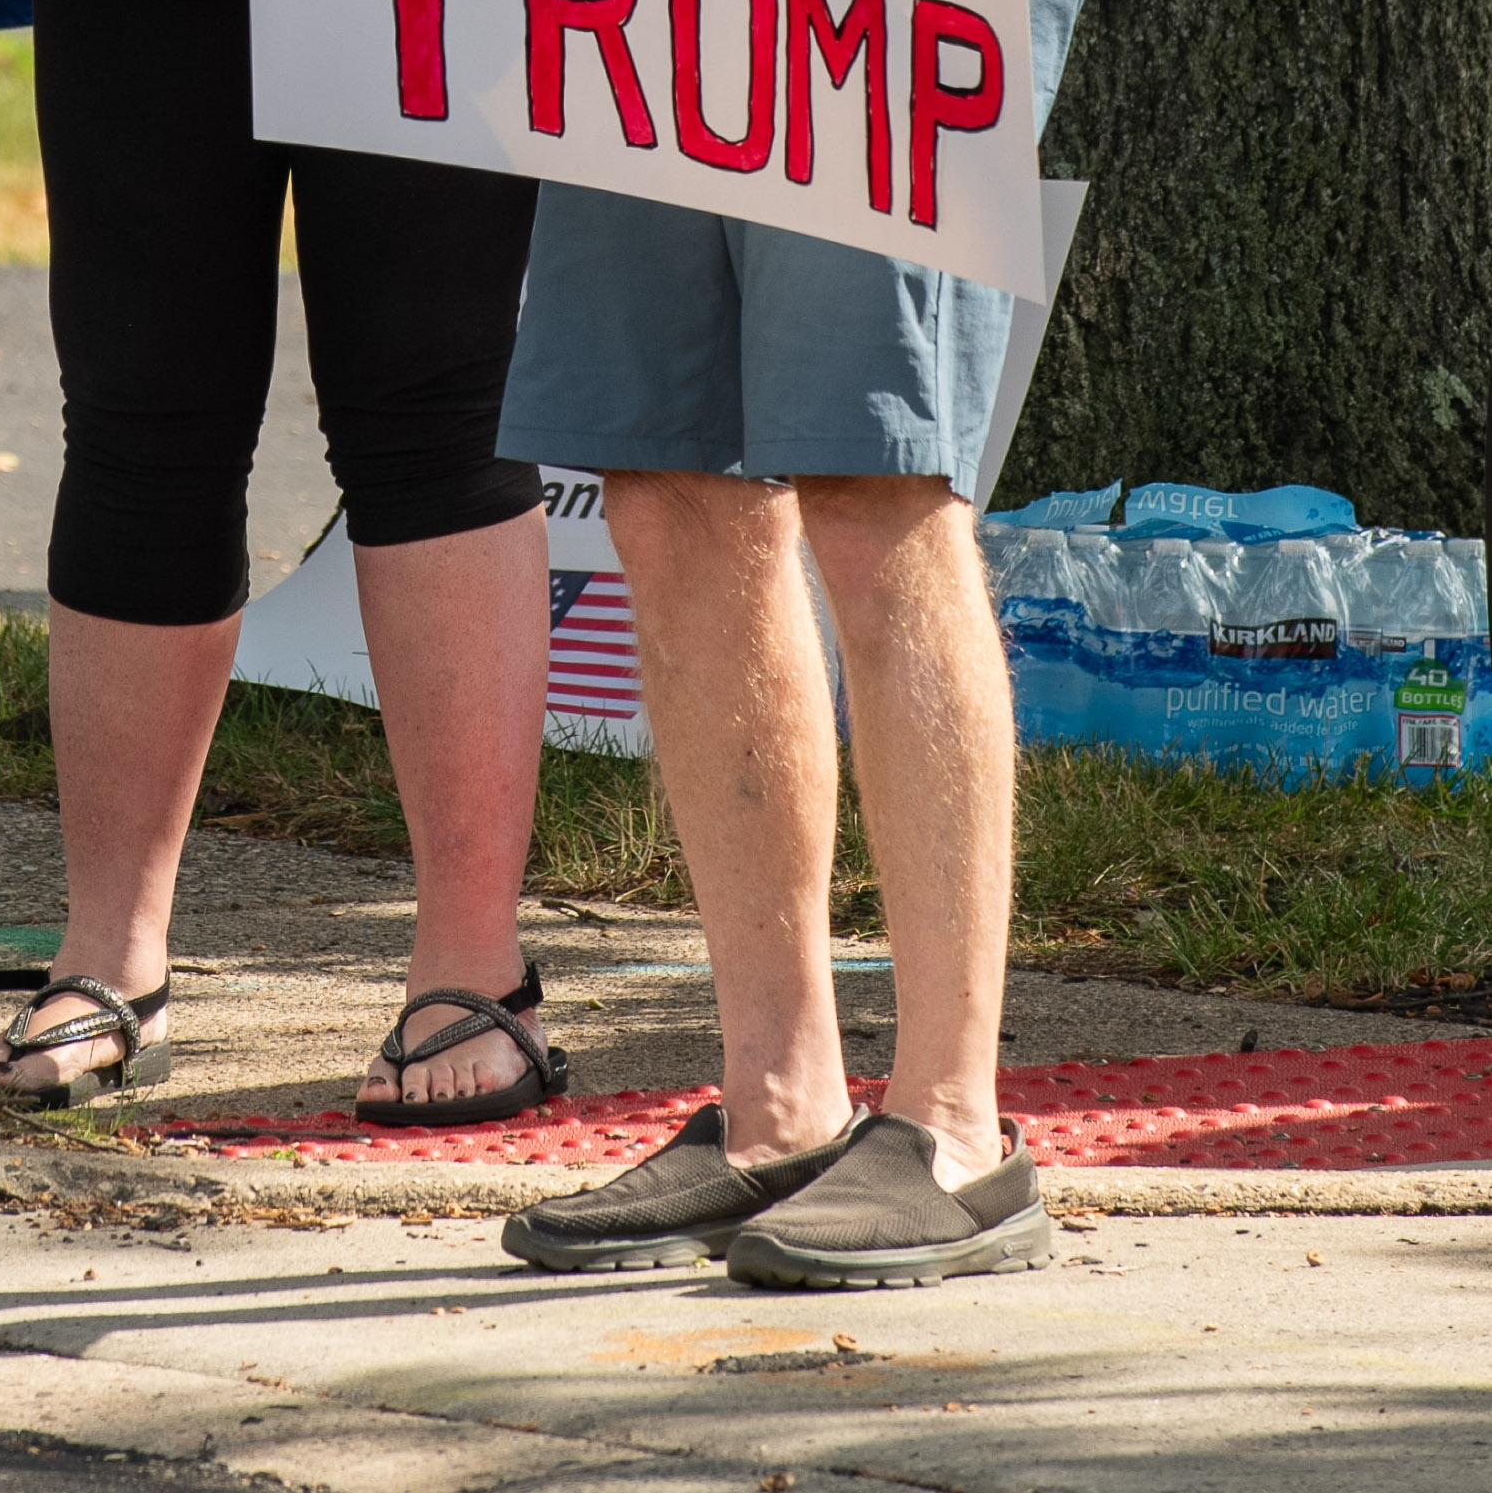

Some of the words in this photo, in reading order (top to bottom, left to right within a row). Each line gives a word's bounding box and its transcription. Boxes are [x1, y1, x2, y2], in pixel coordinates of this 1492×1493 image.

[543, 481, 607, 520] an
[1212, 620, 1336, 645] KIRKLAND
[1408, 667, 1448, 687] 40
[1166, 682, 1285, 718] purified
[1299, 686, 1377, 720] water
[1402, 691, 1463, 709] BOTTLES
[1270, 720, 1313, 736] added
